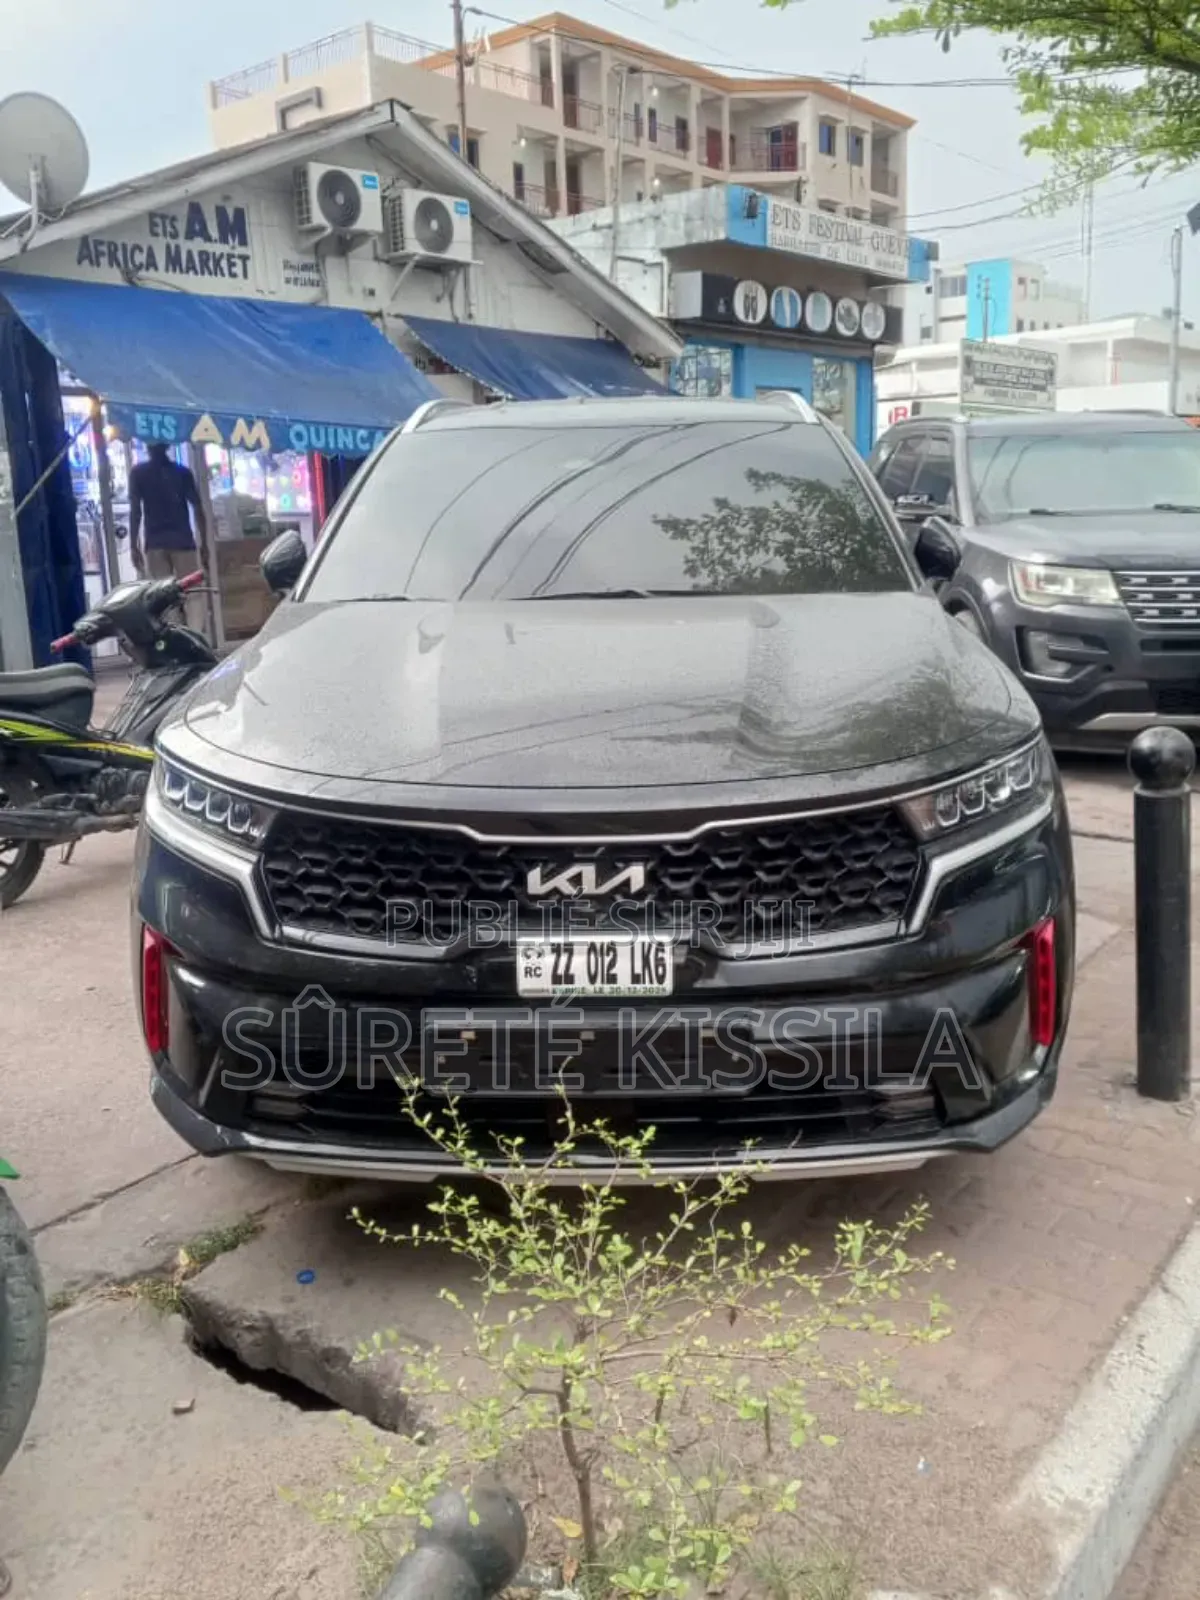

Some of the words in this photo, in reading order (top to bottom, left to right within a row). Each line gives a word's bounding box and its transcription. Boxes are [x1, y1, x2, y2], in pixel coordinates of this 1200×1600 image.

[148, 211, 178, 239] ETS
[772, 204, 801, 231] ETS
[808, 214, 864, 246] FESTIVAL
[76, 234, 158, 272] AFRICA
[165, 243, 251, 280] MARKET
[135, 411, 177, 440] ETS
[527, 862, 645, 896] KIA
[524, 966, 542, 979] RC
[551, 942, 575, 985] ZZ
[586, 942, 619, 985] 012
[630, 942, 667, 985] LK6
